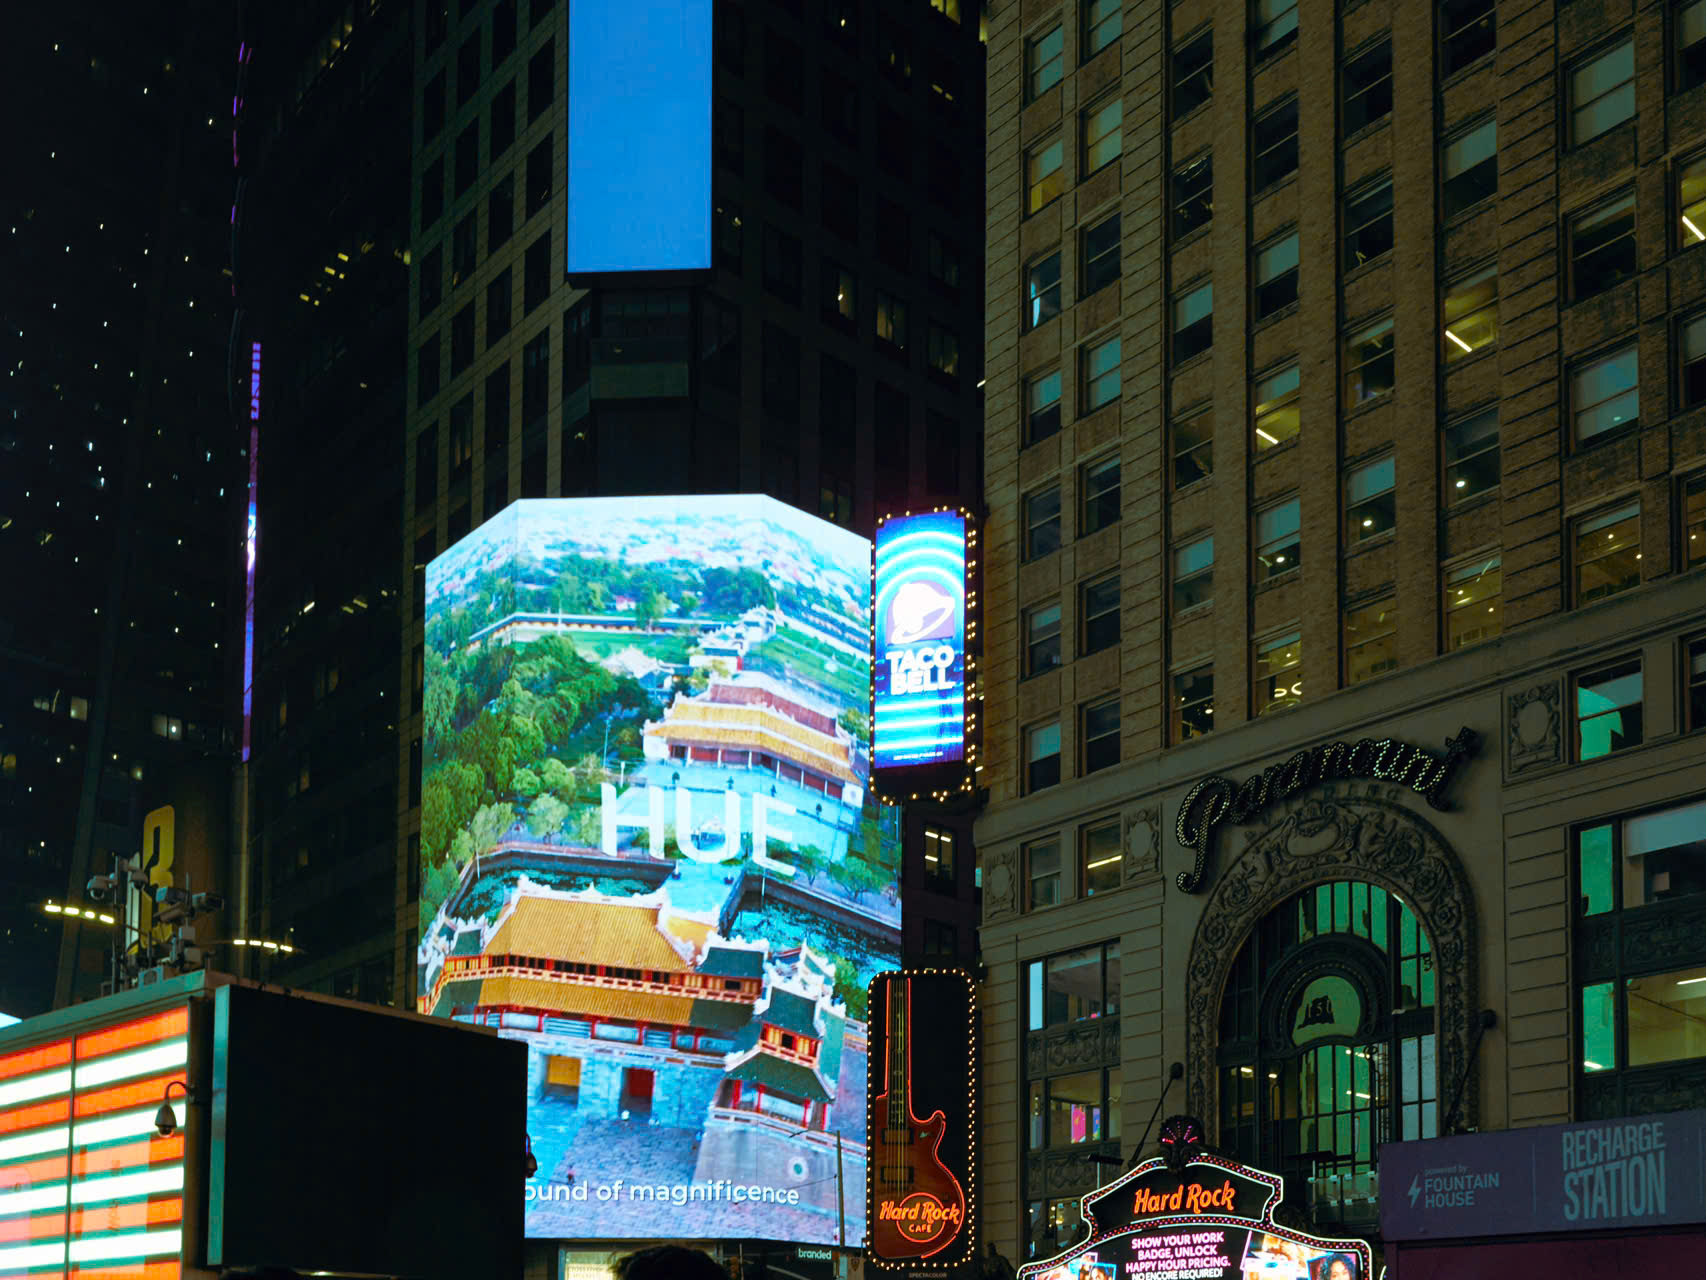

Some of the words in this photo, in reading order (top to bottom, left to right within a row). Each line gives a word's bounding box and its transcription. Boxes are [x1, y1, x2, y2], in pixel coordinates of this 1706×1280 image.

[886, 644, 955, 675] TACO
[890, 668, 957, 695] BELL
[1176, 727, 1477, 893] Paramount
[601, 782, 797, 876] HUE
[1562, 1121, 1665, 1171] RECHARGE
[596, 1180, 624, 1201] of
[630, 1179, 800, 1206] magnificence
[1424, 1172, 1500, 1193] FOUNTAIN
[1564, 1150, 1667, 1221] STATION
[1134, 1185, 1184, 1214] Hard
[1185, 1180, 1236, 1214] Rock
[1425, 1190, 1475, 1208] HOUSE
[880, 1201, 920, 1220] Hard
[921, 1201, 960, 1225] Rock
[908, 1223, 933, 1233] CAFE
[1131, 1237, 1162, 1249] SHOW
[1163, 1234, 1191, 1247] YOUR
[1191, 1232, 1225, 1244] WORK
[1138, 1247, 1174, 1260] BADGE,
[1174, 1245, 1218, 1258] UNLOCK
[798, 1248, 832, 1260] branded
[1125, 1261, 1158, 1273] HAPPY
[1157, 1259, 1187, 1271] HOUR
[1188, 1256, 1231, 1269] PRICING.
[1145, 1270, 1178, 1280] ENCORE
[1179, 1267, 1223, 1280] REQUIRED!
